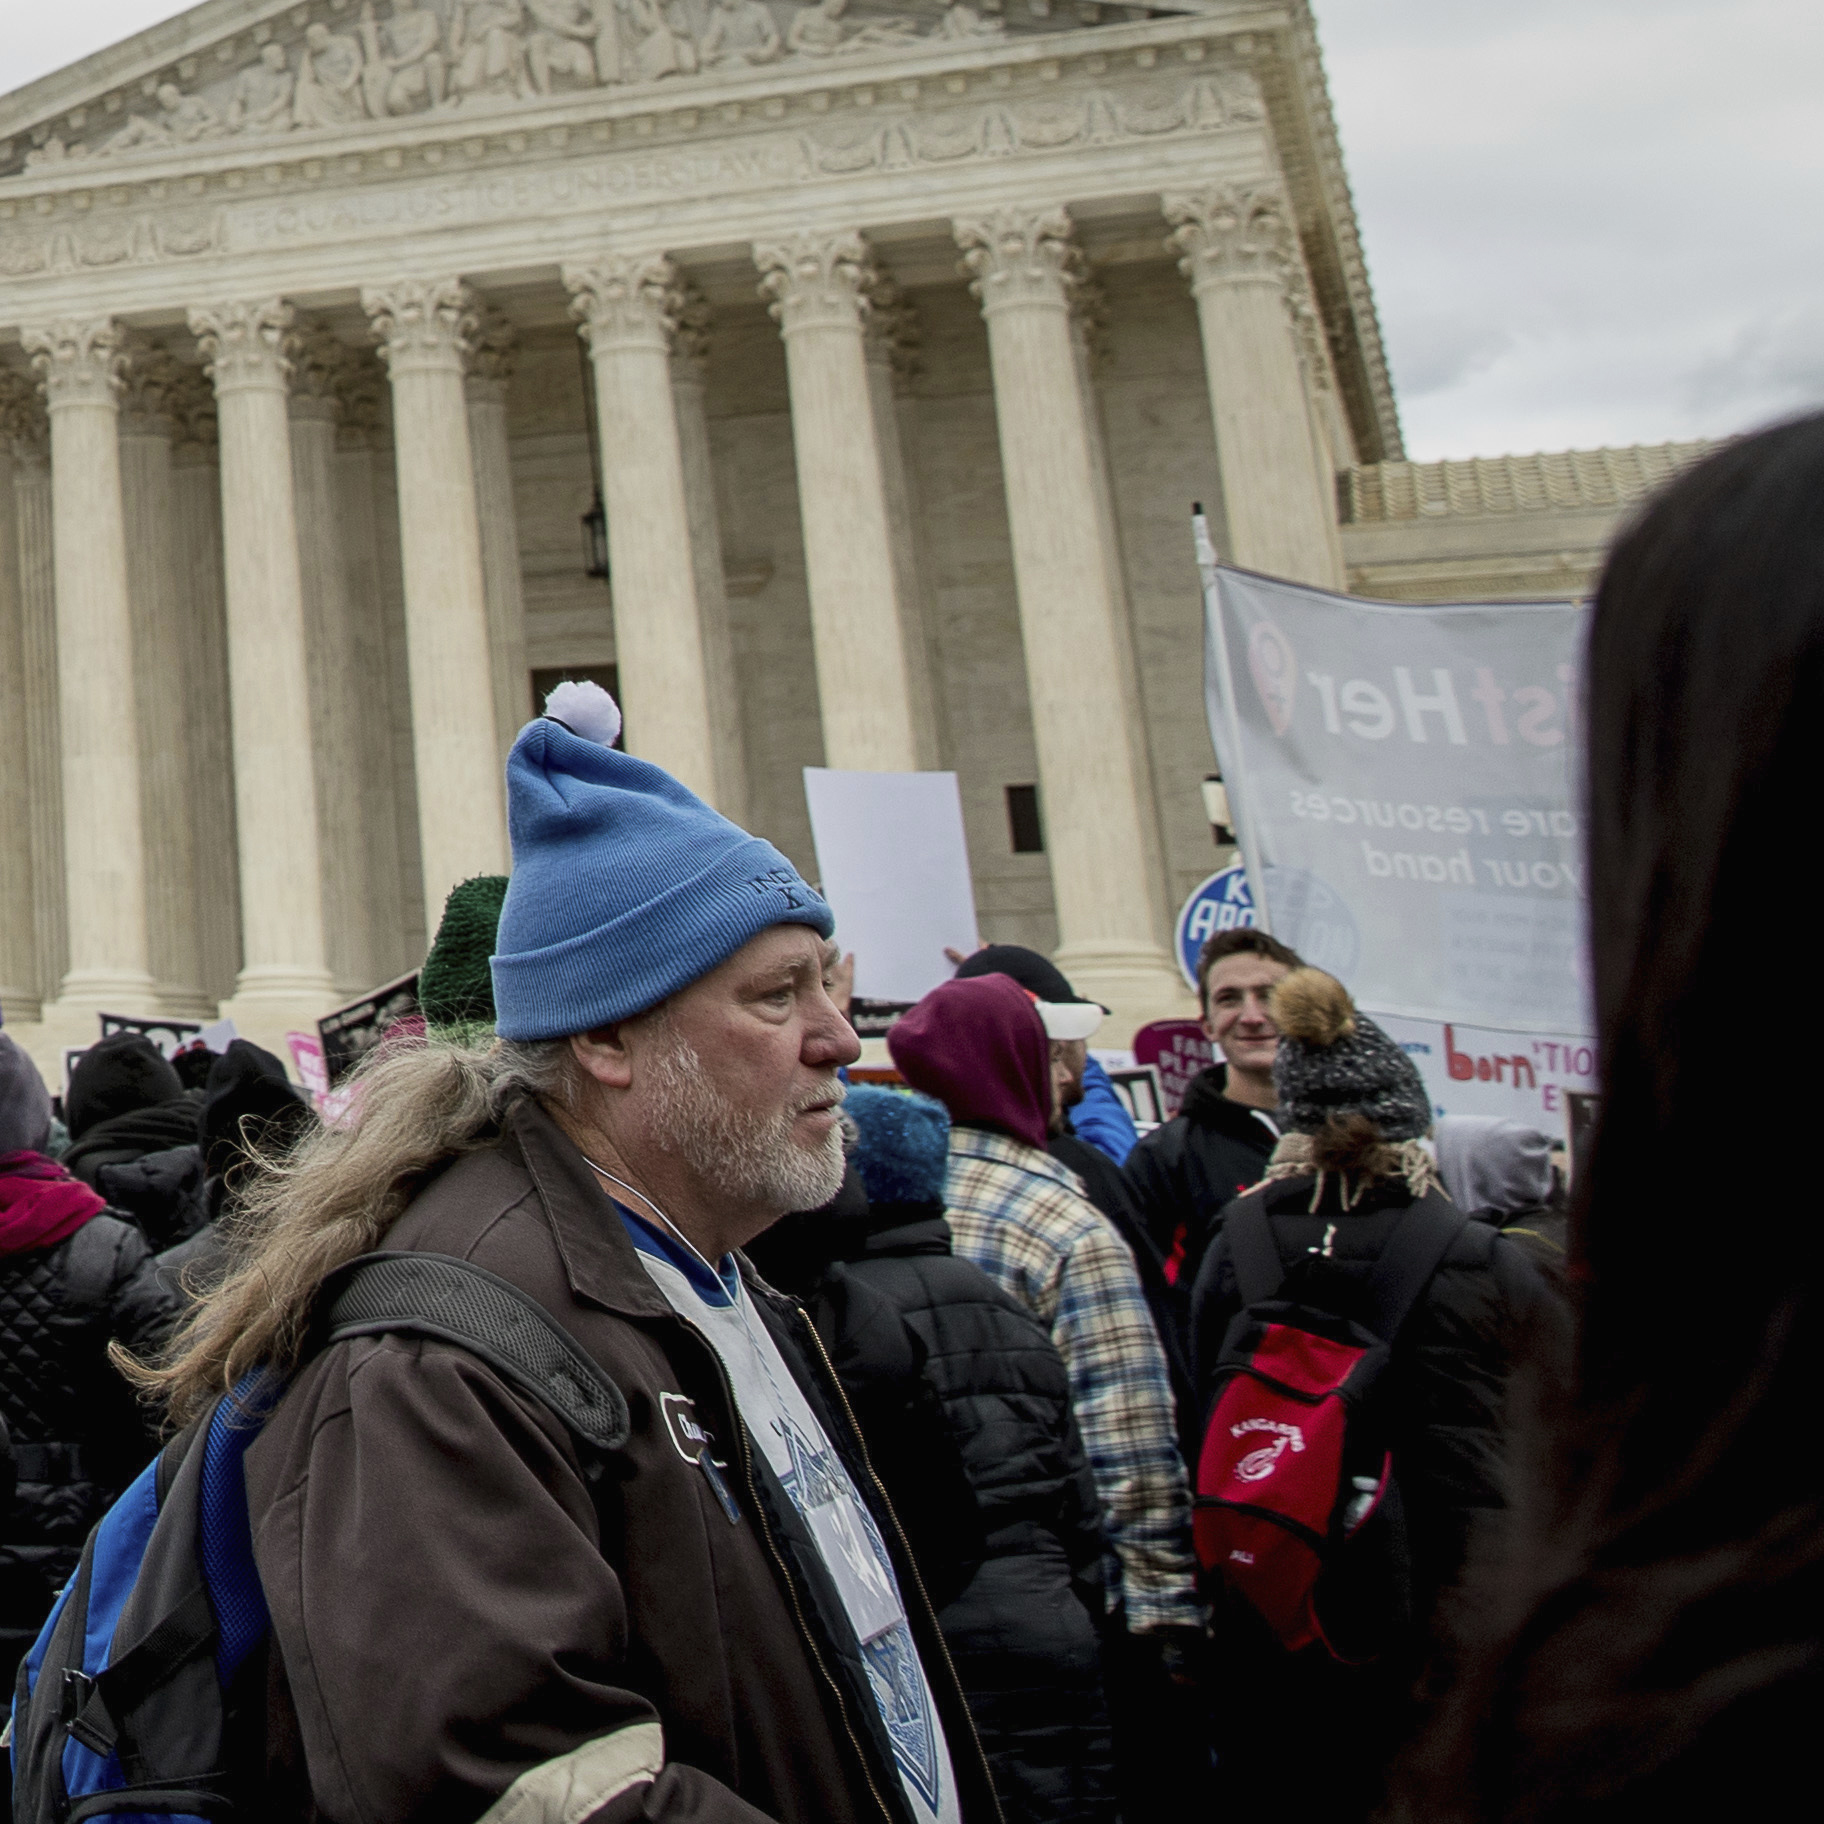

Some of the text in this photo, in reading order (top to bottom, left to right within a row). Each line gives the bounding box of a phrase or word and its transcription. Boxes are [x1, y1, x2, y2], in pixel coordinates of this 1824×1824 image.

[252, 145, 773, 240] EQUAL JUSTICE UNDER LAW
[776, 886, 805, 910] K
[1444, 1023, 1536, 1089] born
